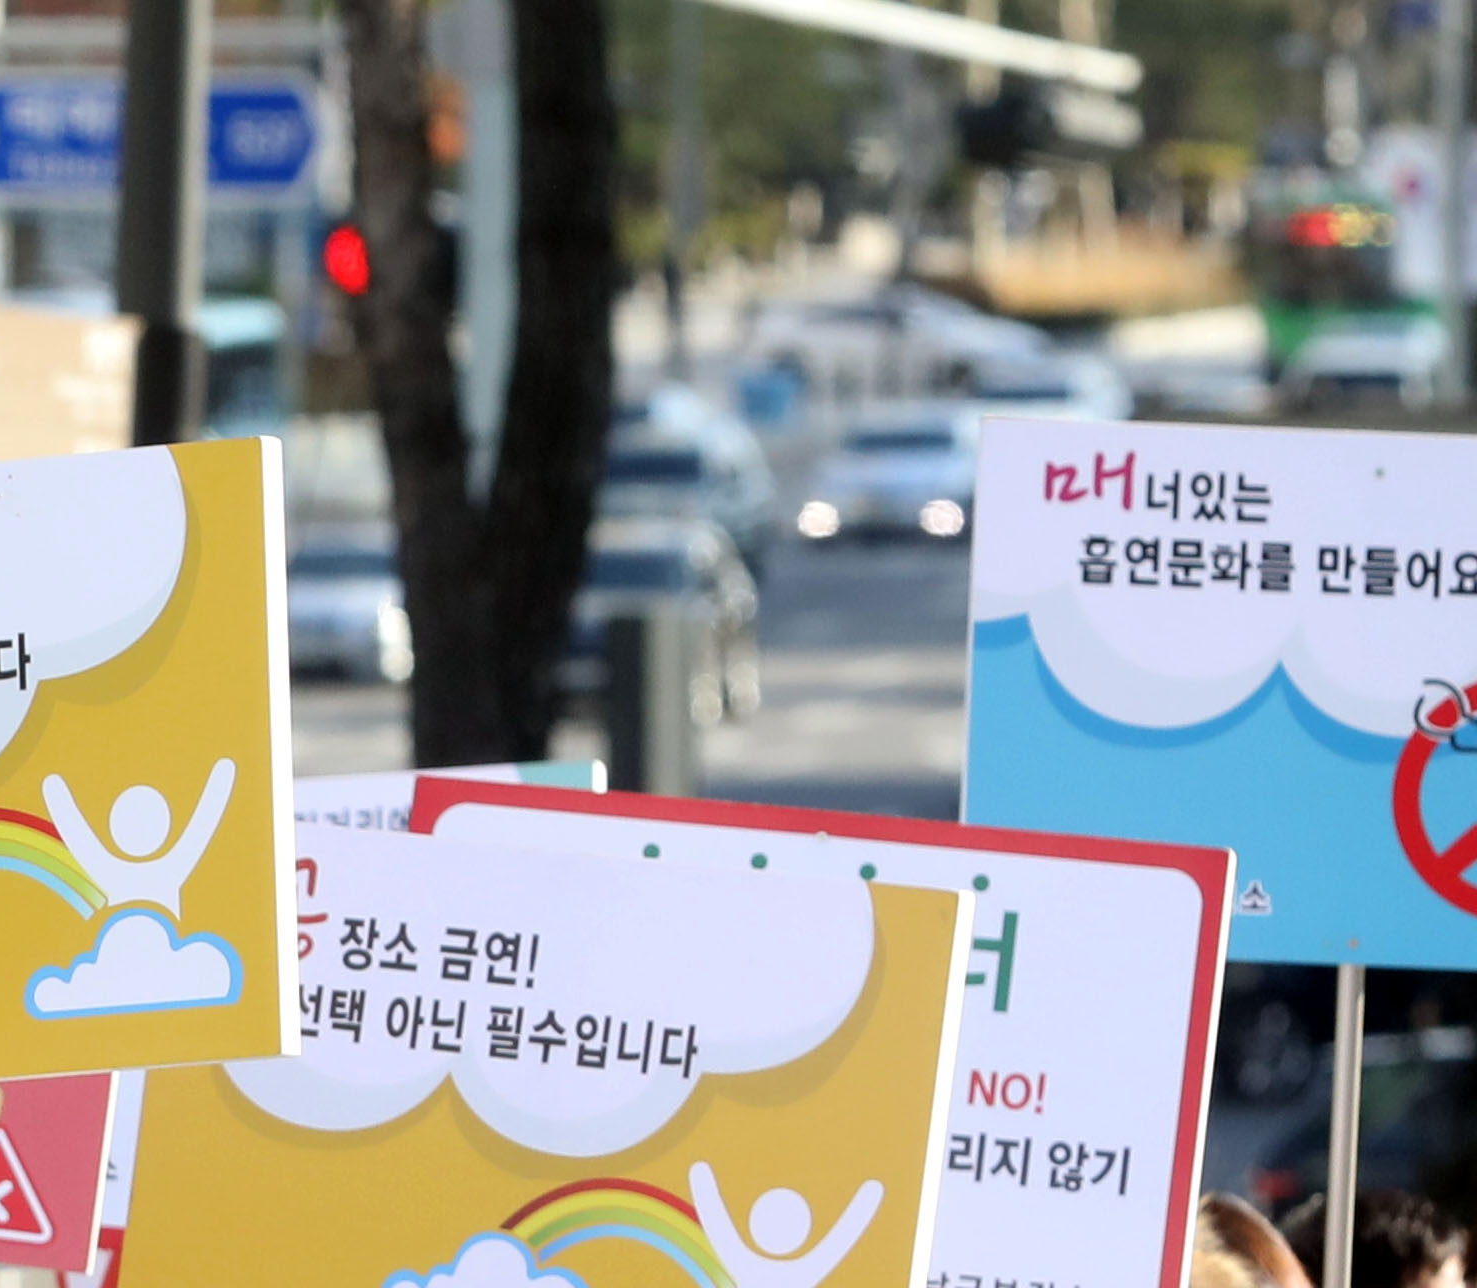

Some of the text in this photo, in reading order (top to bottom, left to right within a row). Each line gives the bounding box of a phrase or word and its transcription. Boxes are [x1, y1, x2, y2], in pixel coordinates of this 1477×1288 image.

[1078, 535, 1297, 592] 흡연문화를
[439, 924, 541, 989] 금연!
[299, 984, 699, 1080] 선택 아닌 필수입니다
[967, 1069, 1047, 1114] NO!
[1047, 1141, 1132, 1196] 않기
